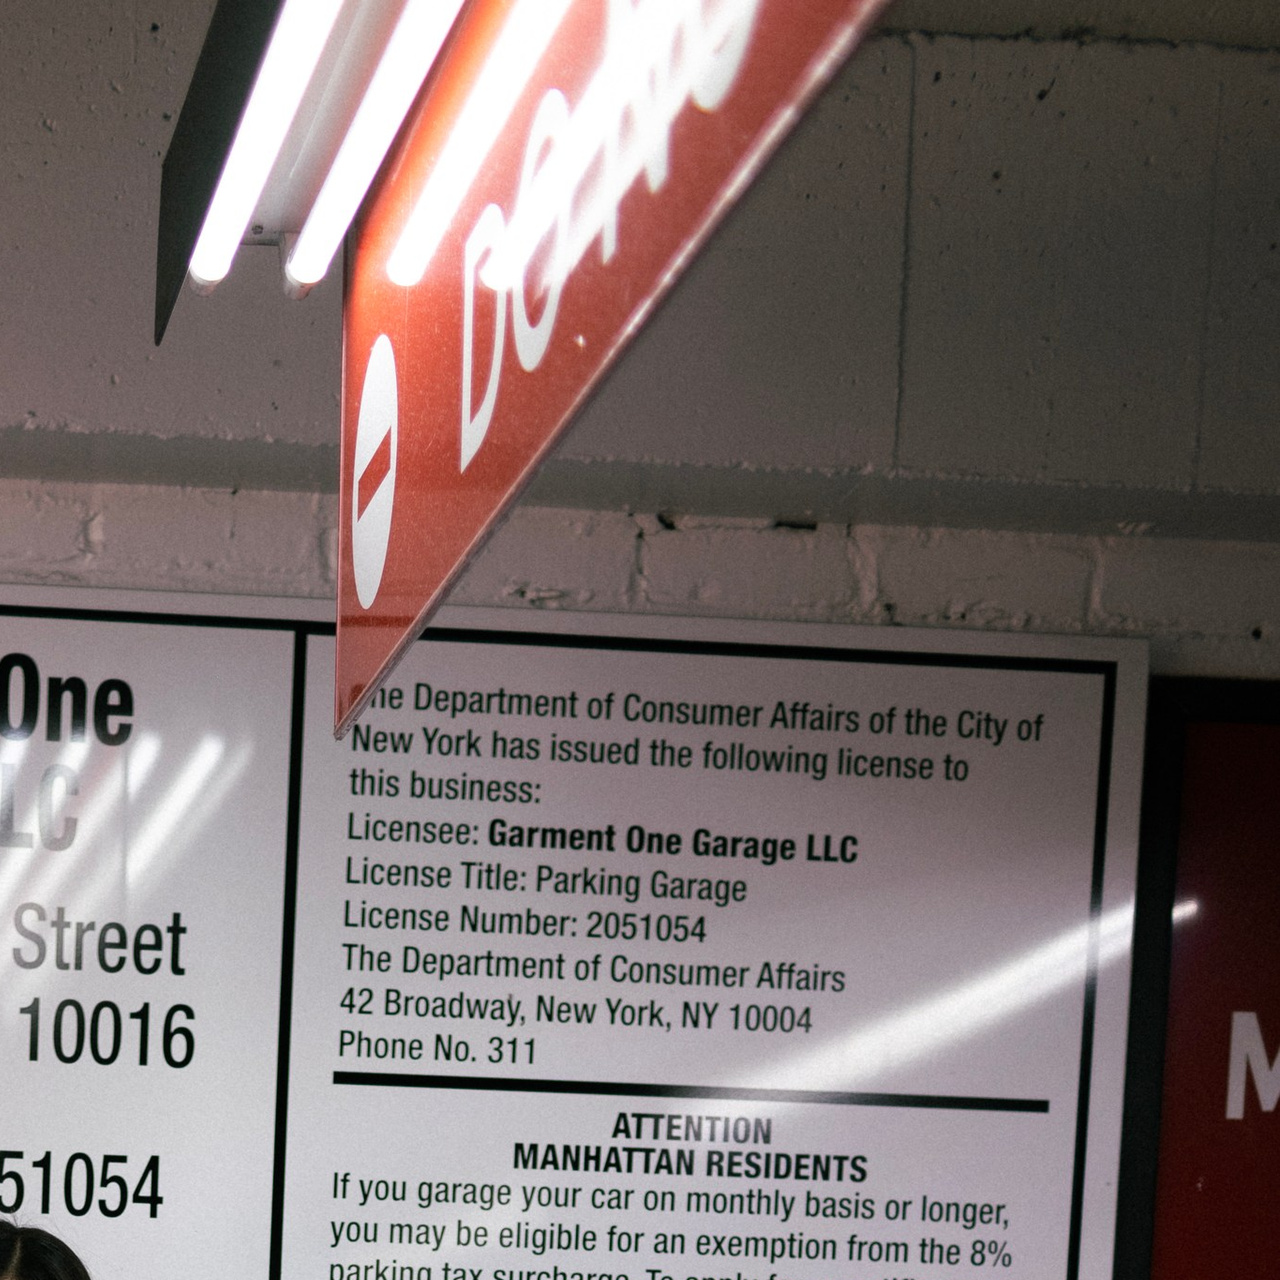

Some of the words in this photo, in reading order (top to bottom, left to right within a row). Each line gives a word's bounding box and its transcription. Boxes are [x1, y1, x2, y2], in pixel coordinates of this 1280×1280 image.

[413, 682, 579, 719] Department
[586, 691, 616, 720] of
[623, 692, 764, 728] Consumer
[768, 700, 860, 733] Affairs
[868, 705, 897, 735] of
[904, 707, 948, 738] the
[956, 709, 1009, 747] City
[1016, 713, 1045, 742] of
[347, 811, 479, 846] Licensee:
[488, 818, 617, 852] Garment
[625, 824, 683, 856] One
[691, 828, 797, 866] Garage
[806, 833, 859, 864] LLC
[345, 856, 452, 889] License
[460, 861, 527, 892] Title:
[536, 864, 641, 904] Parking
[650, 869, 747, 908] Garage
[12, 902, 187, 976] Street
[344, 899, 450, 932] License
[460, 904, 577, 937] Number:
[586, 910, 707, 943] 2051054
[341, 943, 392, 973] The
[402, 945, 566, 981] Department
[574, 953, 602, 981] of
[610, 954, 751, 988] Consumer
[755, 961, 846, 993] Affairs
[20, 998, 195, 1069] 10016
[339, 987, 374, 1015] 42
[384, 988, 526, 1028] Broadway,
[536, 994, 597, 1024] New
[605, 997, 672, 1032] York,
[681, 1001, 719, 1029] NY
[729, 1003, 813, 1033] 10004
[339, 1029, 423, 1060] Phone
[434, 1033, 476, 1062] No.
[487, 1036, 535, 1065] 311
[611, 1112, 772, 1145] ATTENTION
[514, 1143, 694, 1176] MANHATTAN
[706, 1150, 867, 1183] RESIDENTS
[333, 1172, 351, 1199] If
[358, 1179, 407, 1207] you
[417, 1181, 512, 1211] garage
[521, 1185, 582, 1213] your
[591, 1187, 635, 1210] car
[643, 1190, 676, 1212] on
[686, 1188, 796, 1223] monthly
[805, 1190, 875, 1220] basis
[884, 1199, 913, 1221] or
[921, 1195, 1009, 1230] longer,
